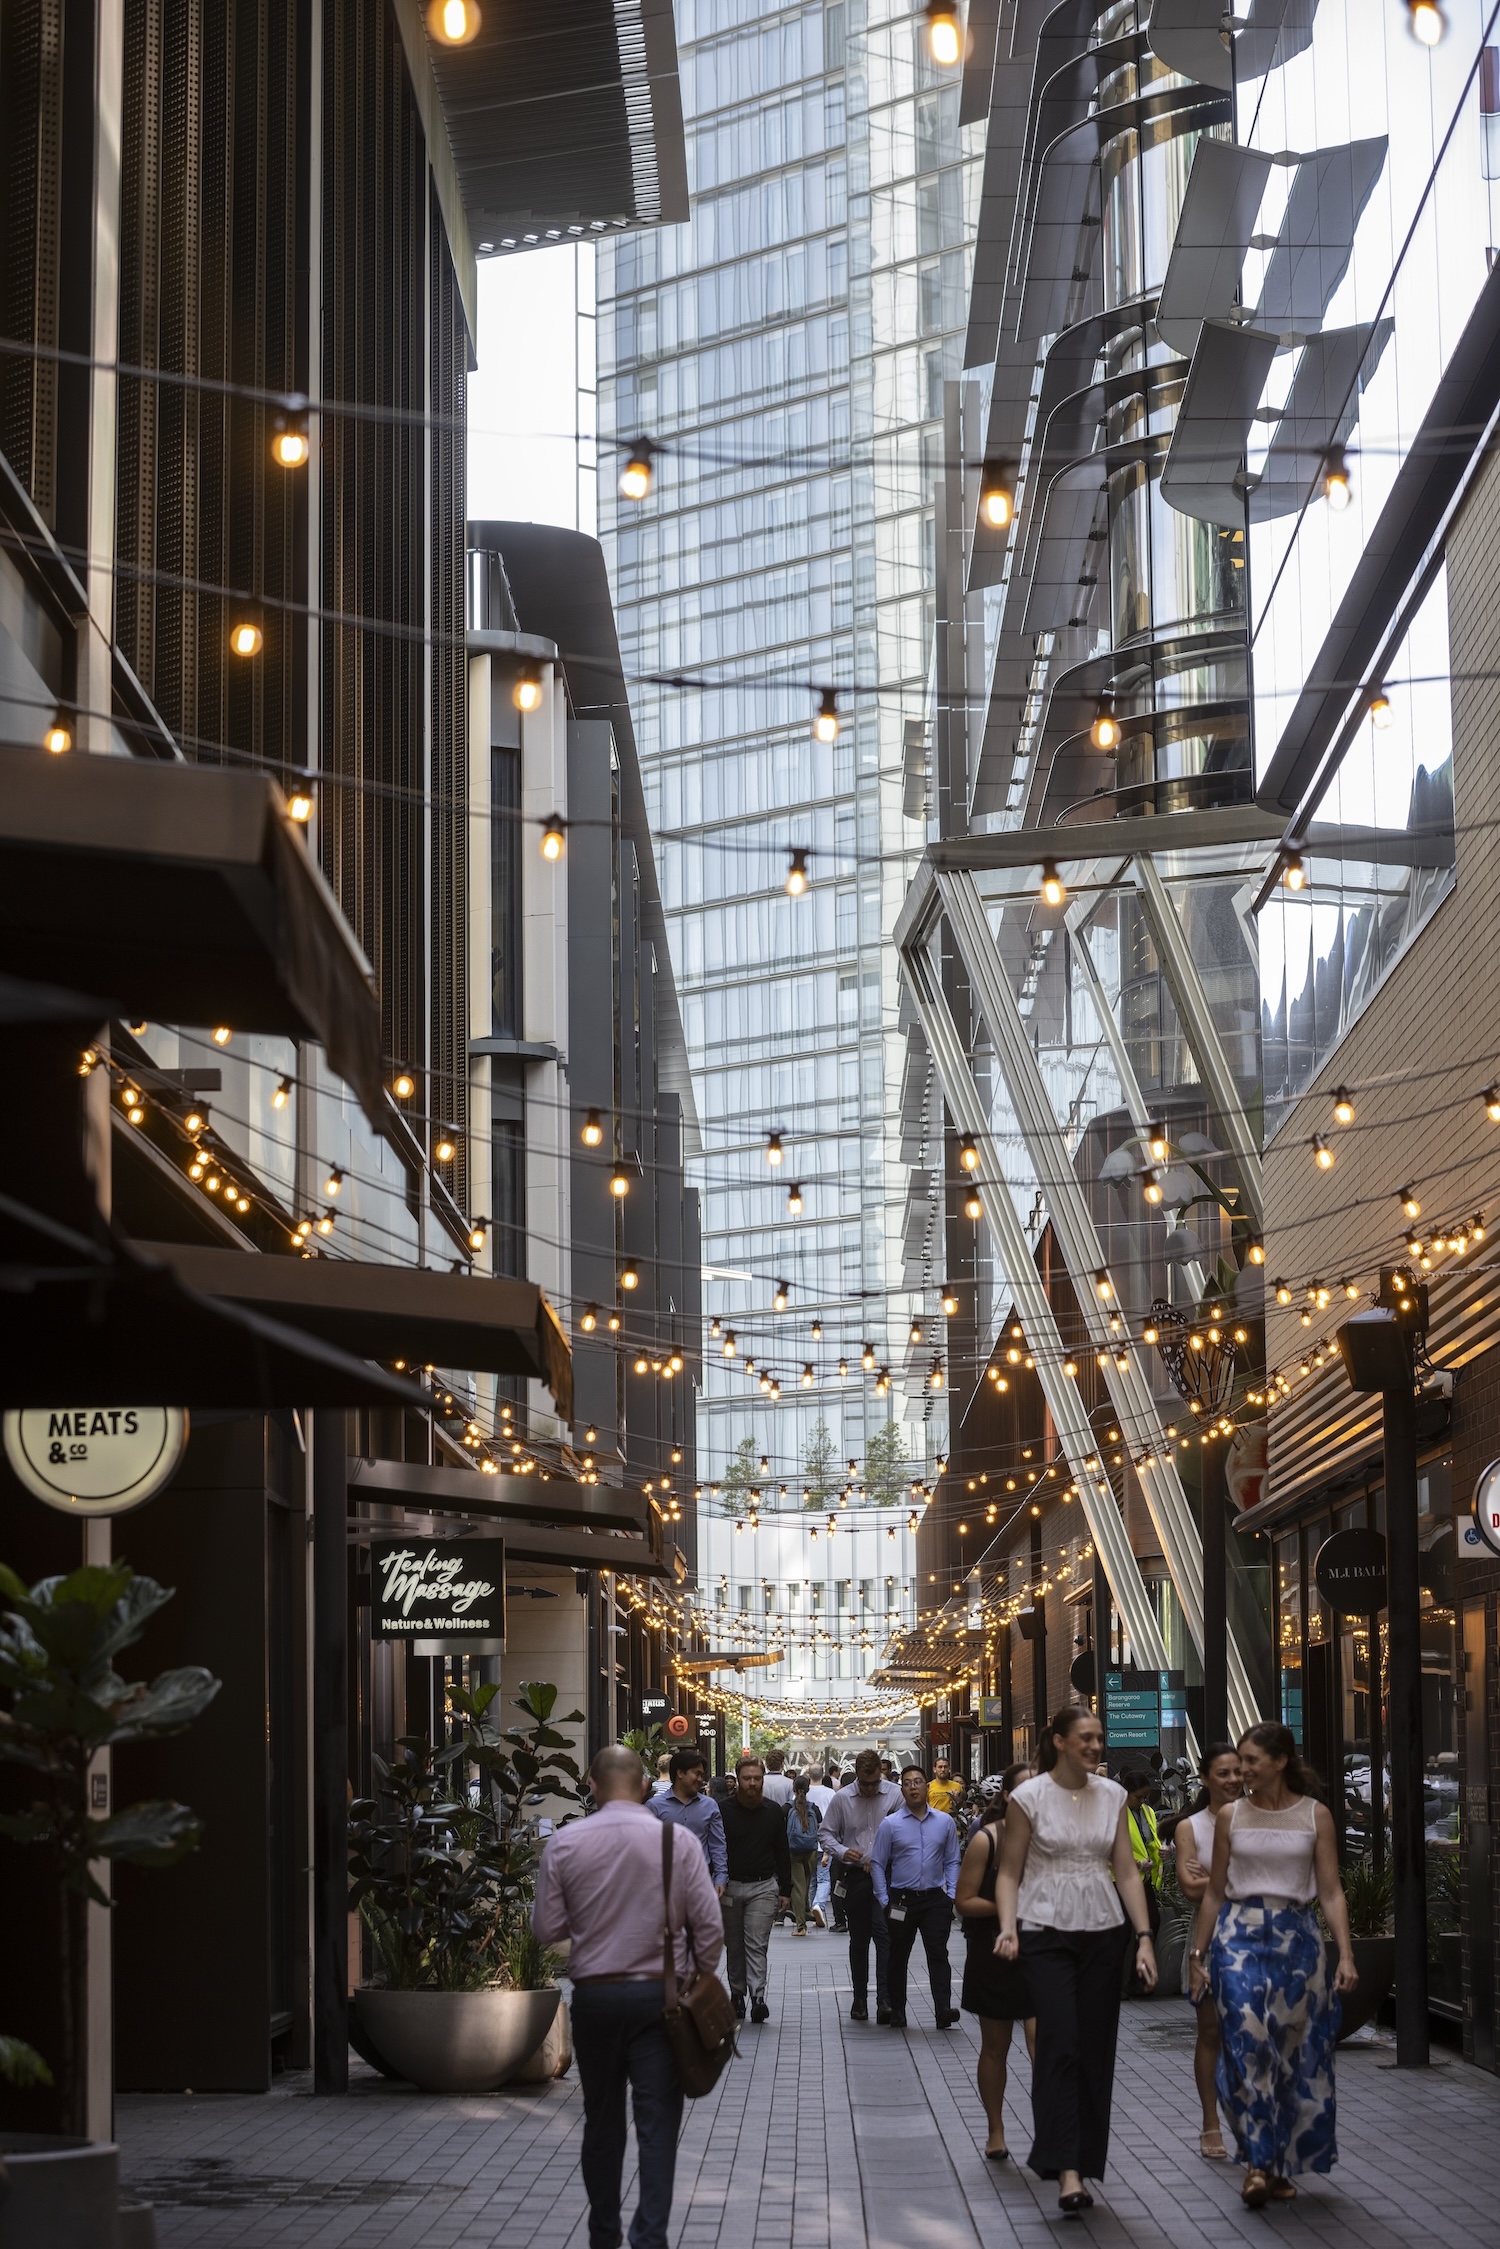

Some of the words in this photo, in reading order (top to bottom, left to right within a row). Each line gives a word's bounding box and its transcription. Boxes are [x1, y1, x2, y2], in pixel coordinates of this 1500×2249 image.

[48, 1411, 138, 1437] MEATS
[48, 1442, 67, 1464] &
[379, 1548, 463, 1583] Healing
[382, 1573, 495, 1617] Massage
[382, 1617, 490, 1630] Nature&Wellness
[1108, 1694, 1140, 1702] Barangaroo
[1121, 1712, 1146, 1720] Cutaway
